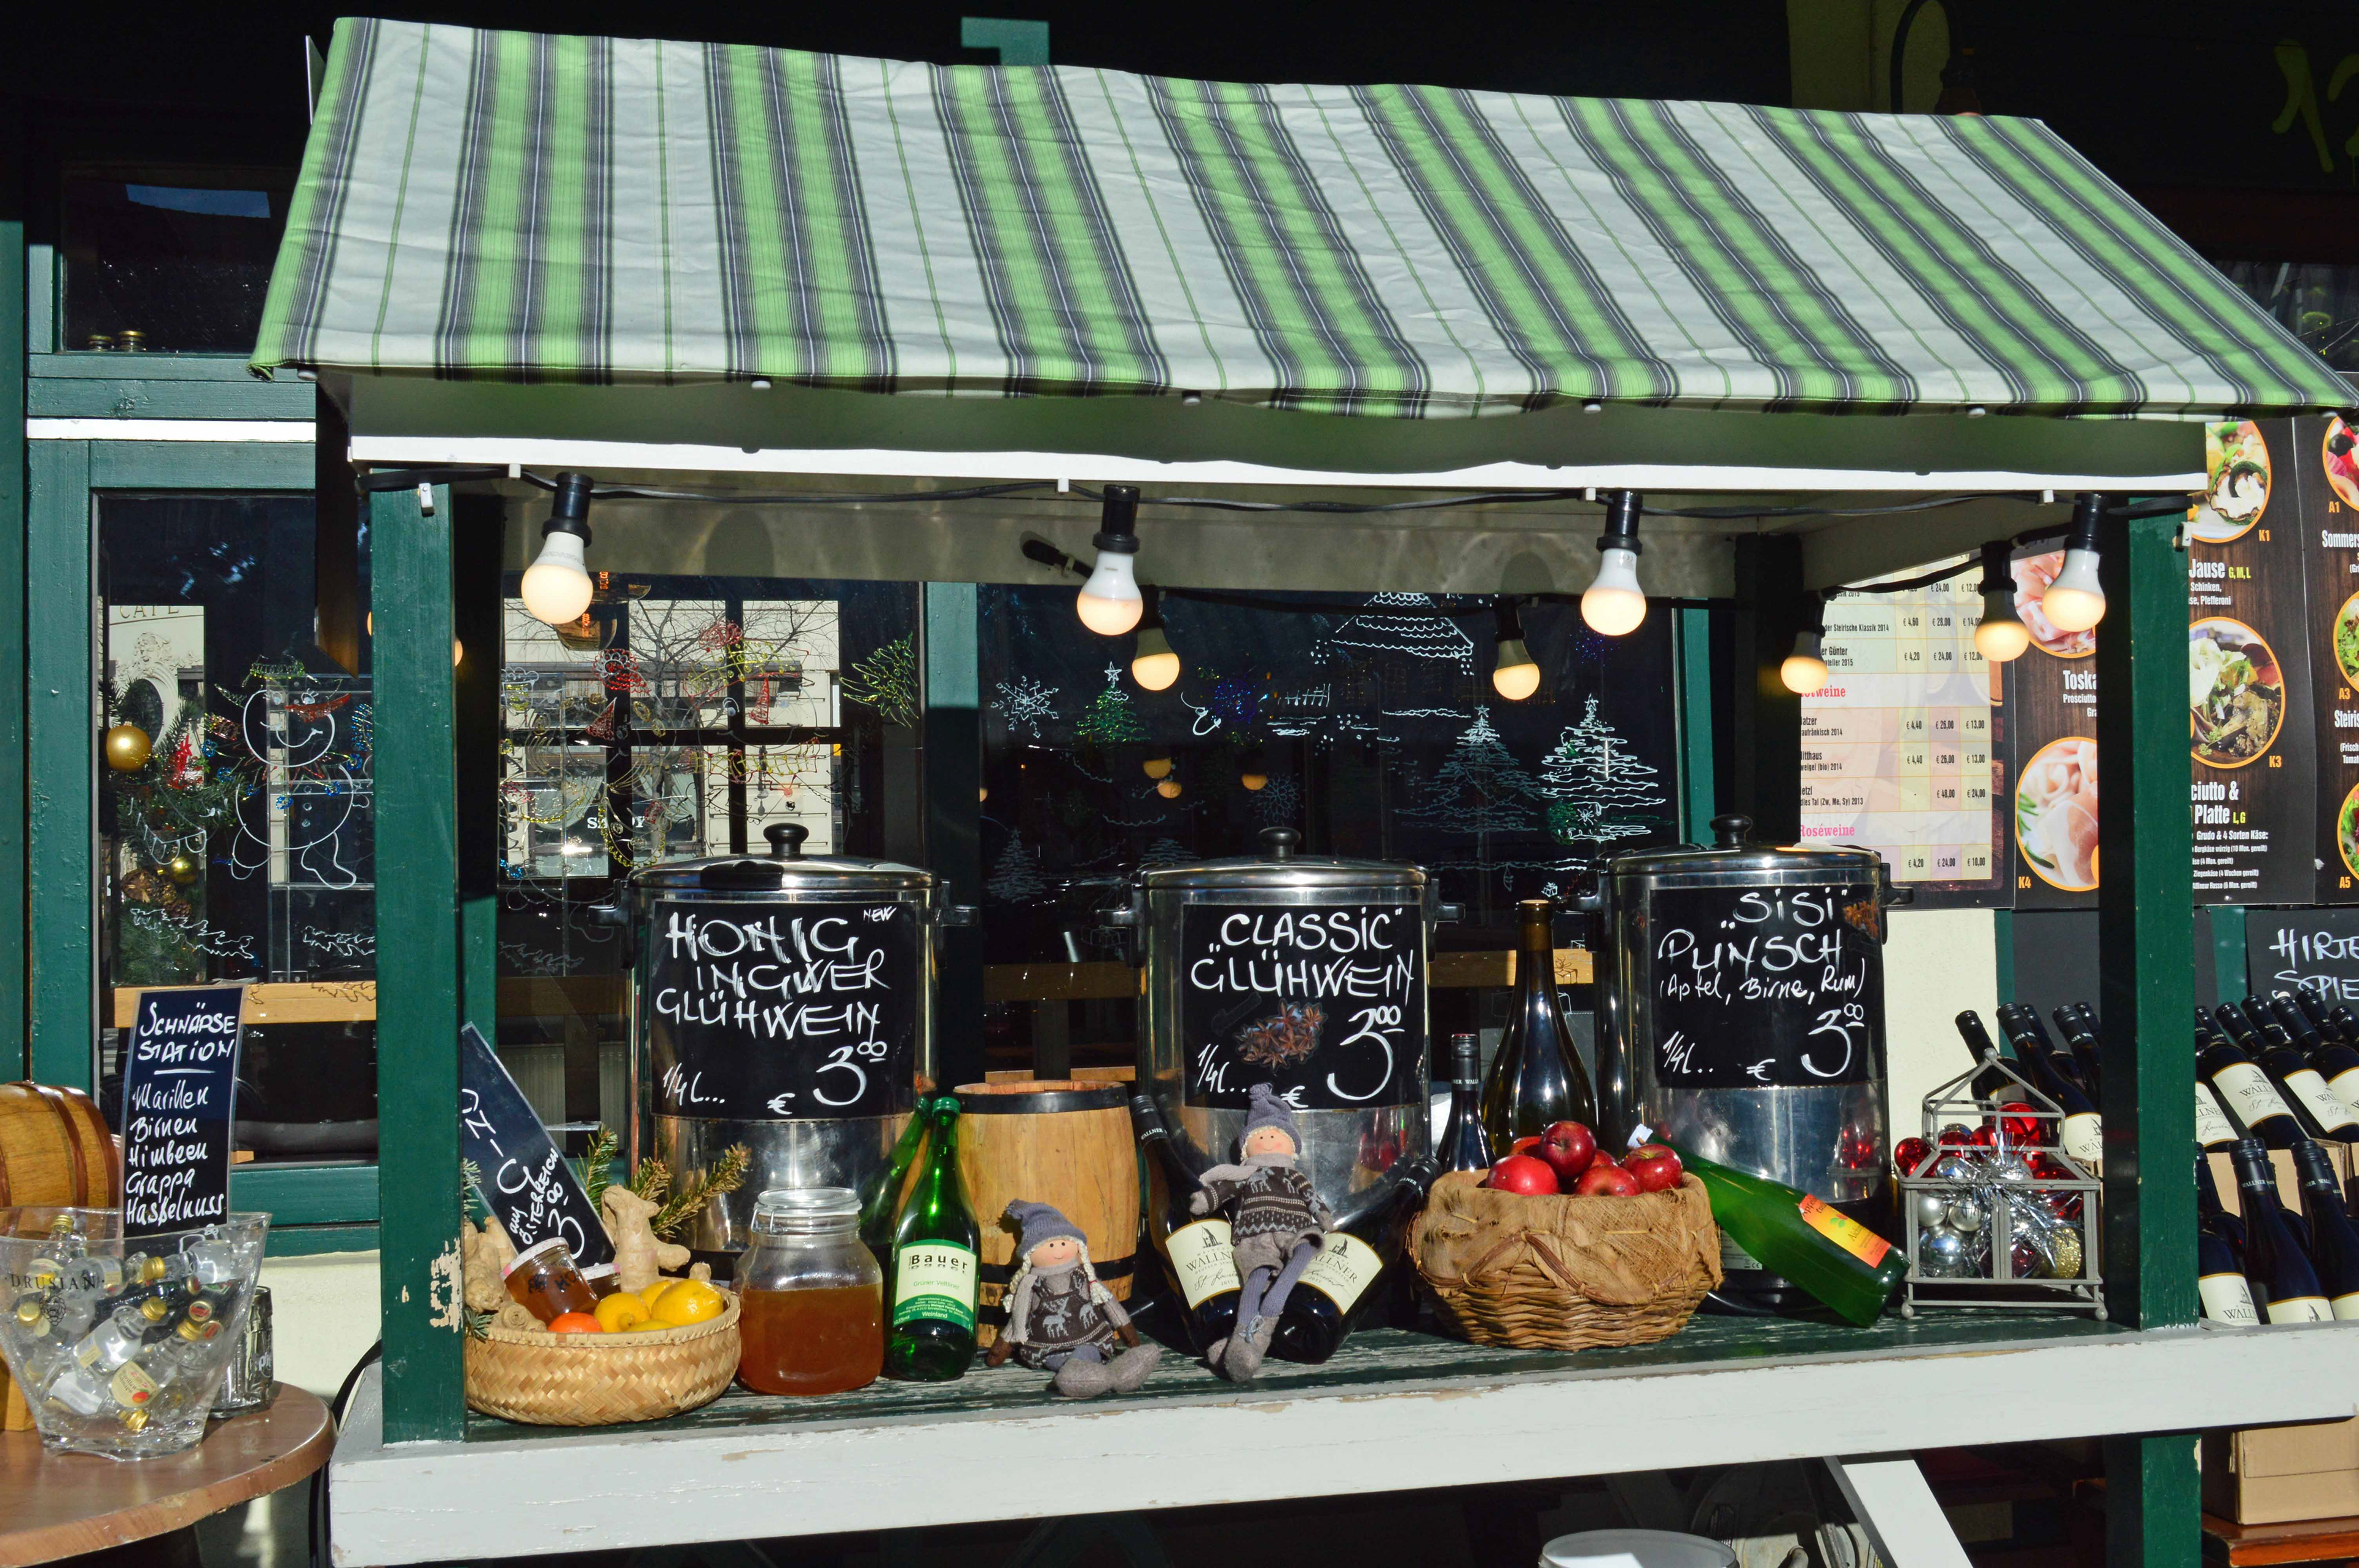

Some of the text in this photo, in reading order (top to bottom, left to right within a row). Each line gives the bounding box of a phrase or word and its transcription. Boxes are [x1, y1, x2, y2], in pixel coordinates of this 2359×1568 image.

[2329, 501, 2340, 513] A1
[2259, 529, 2271, 542] K1
[2189, 558, 2226, 579] Jause
[1936, 583, 1949, 593] 24,00
[2190, 582, 2222, 593] Schinken,
[2188, 596, 2199, 606] se,
[1833, 623, 1858, 632] Steirische
[1859, 623, 1877, 632] Klassik
[1877, 623, 1889, 631] 2014
[1937, 617, 1950, 626] 28,00
[1829, 647, 1848, 657] Günter
[1909, 652, 1920, 661] 4,20
[1938, 652, 1952, 661] 24,00
[2338, 687, 2351, 700] A3
[1911, 720, 1922, 730] 4,40
[1940, 720, 1954, 729] 26,00
[1971, 720, 1985, 729] 13,00
[1912, 754, 1923, 764] 4,40
[1941, 754, 1955, 763] 26,00
[1971, 754, 1985, 763] 13,00
[2269, 755, 2282, 768] K3
[1830, 762, 1842, 771] 2014
[1941, 789, 1955, 798] 48,00
[1971, 789, 1985, 798] 24,00
[2229, 781, 2239, 801] &
[1852, 797, 1863, 806] 2013
[2194, 804, 2230, 824] Platte
[2216, 830, 2222, 840] &
[2223, 831, 2228, 840] 4
[2229, 830, 2249, 840] Sorten
[2250, 829, 2269, 840] Käse:
[1913, 858, 1924, 868] 4,20
[1942, 858, 1956, 867] 24,00
[1972, 857, 1985, 867] 10,00
[2019, 876, 2032, 889] K4
[2339, 876, 2351, 888] A5
[1658, 928, 1842, 979] PUNSCH
[697, 949, 892, 1000] INGWER
[1191, 949, 1414, 1006] GLÜHWEIN
[140, 1002, 237, 1037] SCHNÄPSE
[657, 988, 880, 1042] GLÜHWEIN
[1747, 1059, 1775, 1080] €
[132, 1079, 209, 1111] Marillen
[1281, 1086, 1309, 1108] €
[767, 1093, 796, 1115] €
[130, 1117, 198, 1143] Birnen
[126, 1168, 195, 1201] Grappa
[911, 1254, 968, 1270] Bauer
[11, 1273, 96, 1290] DRUSIAN
